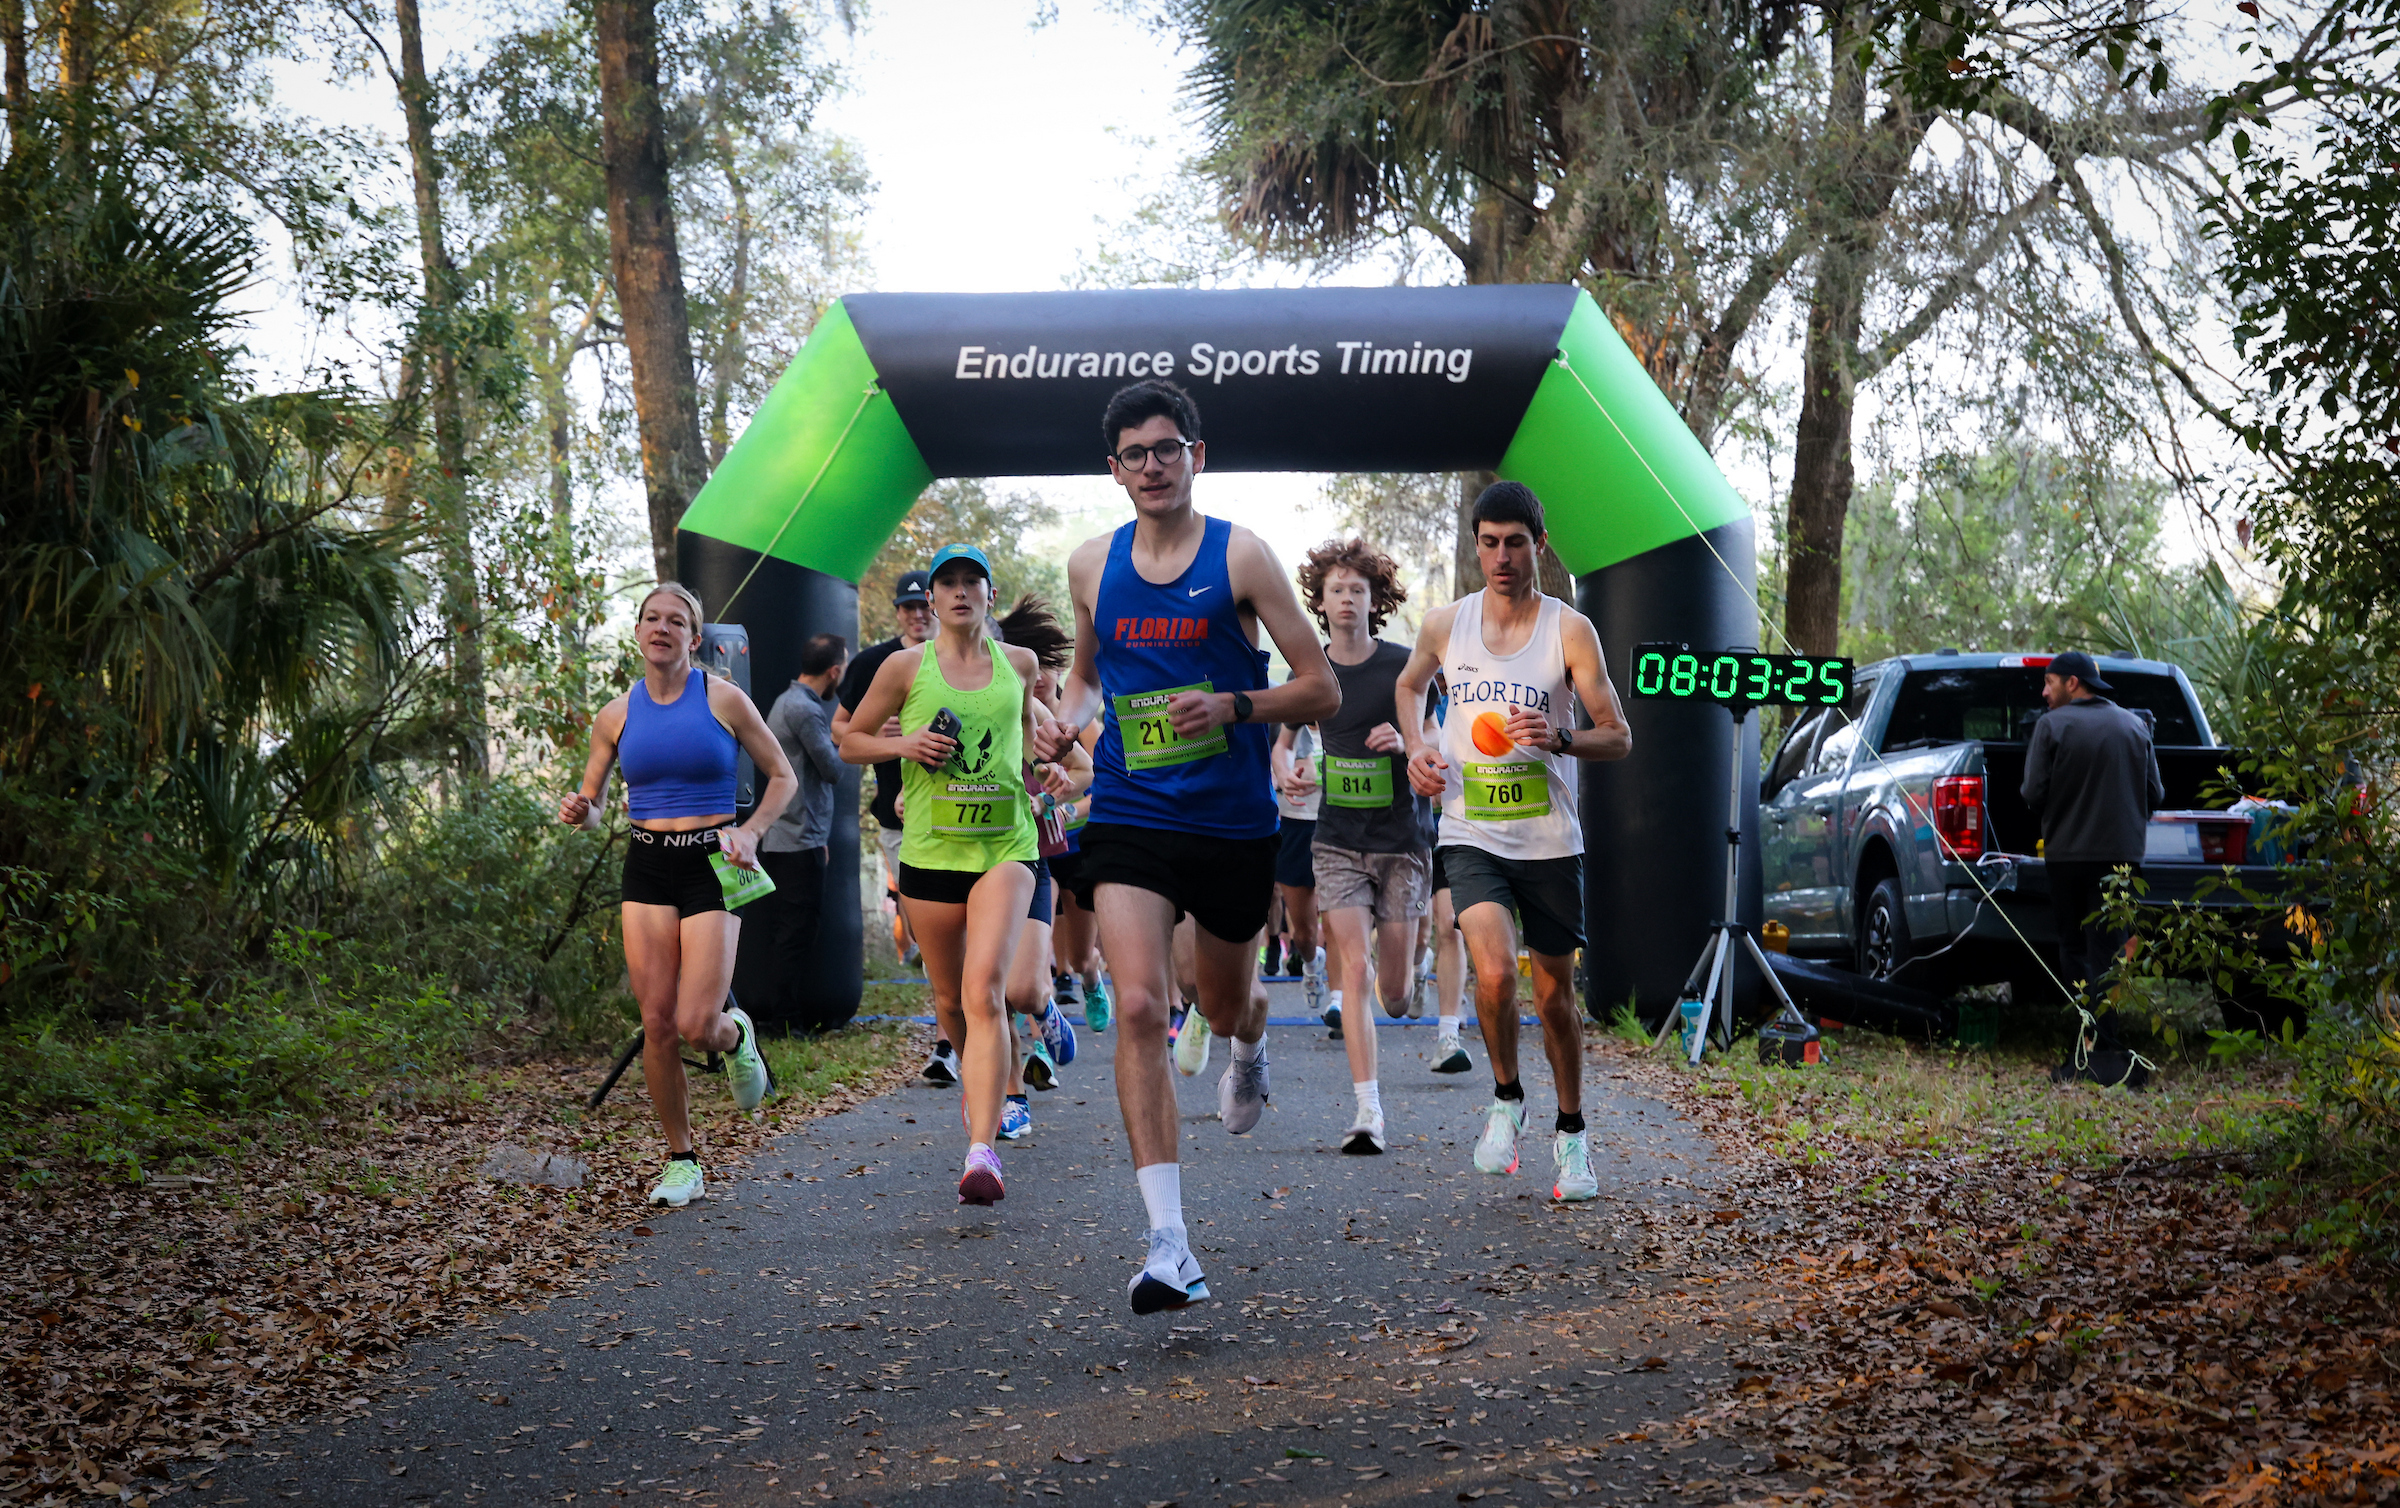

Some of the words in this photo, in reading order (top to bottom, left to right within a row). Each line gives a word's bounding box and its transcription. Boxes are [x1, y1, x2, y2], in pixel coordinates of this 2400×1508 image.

[955, 345, 1175, 380] Endurance
[1187, 342, 1320, 384] Sports
[1336, 341, 1472, 383] Timing
[1114, 617, 1208, 641] FLORIDA
[1125, 641, 1170, 649] RUNNING
[1636, 652, 1844, 704] 08:03:25
[1129, 693, 1174, 709] ENDURA
[1451, 680, 1550, 714] FLORIDA
[1342, 776, 1372, 793] 814
[1485, 783, 1523, 804] 760
[955, 803, 992, 823] 772
[663, 829, 718, 847] NIKE
